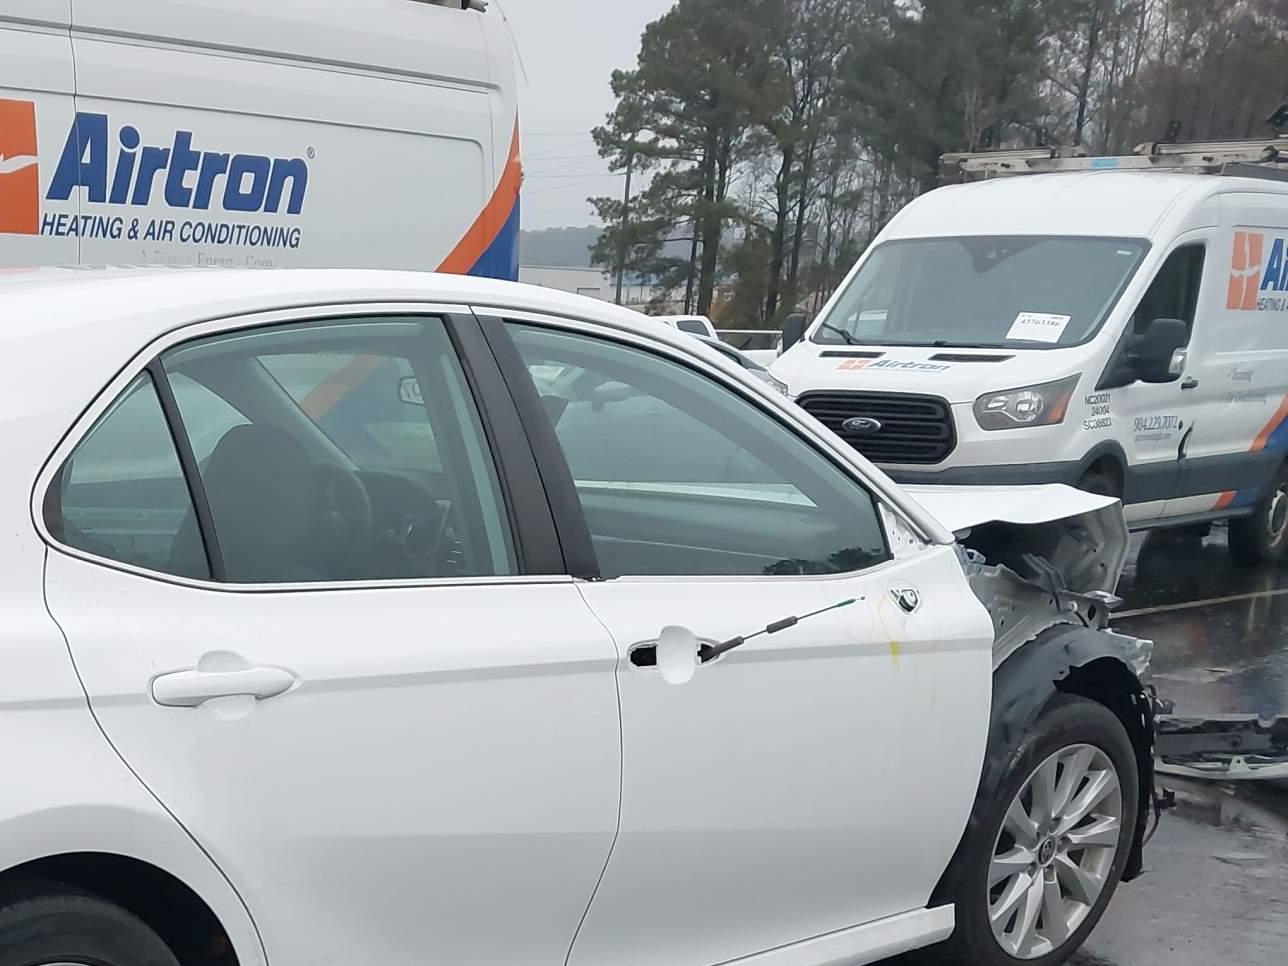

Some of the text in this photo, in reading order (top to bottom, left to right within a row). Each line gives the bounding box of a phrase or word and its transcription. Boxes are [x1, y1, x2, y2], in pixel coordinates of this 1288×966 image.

[45, 111, 308, 215] Airtron
[40, 213, 301, 249] HEATING & AIR CONDITIONING
[866, 359, 952, 371] Airtron
